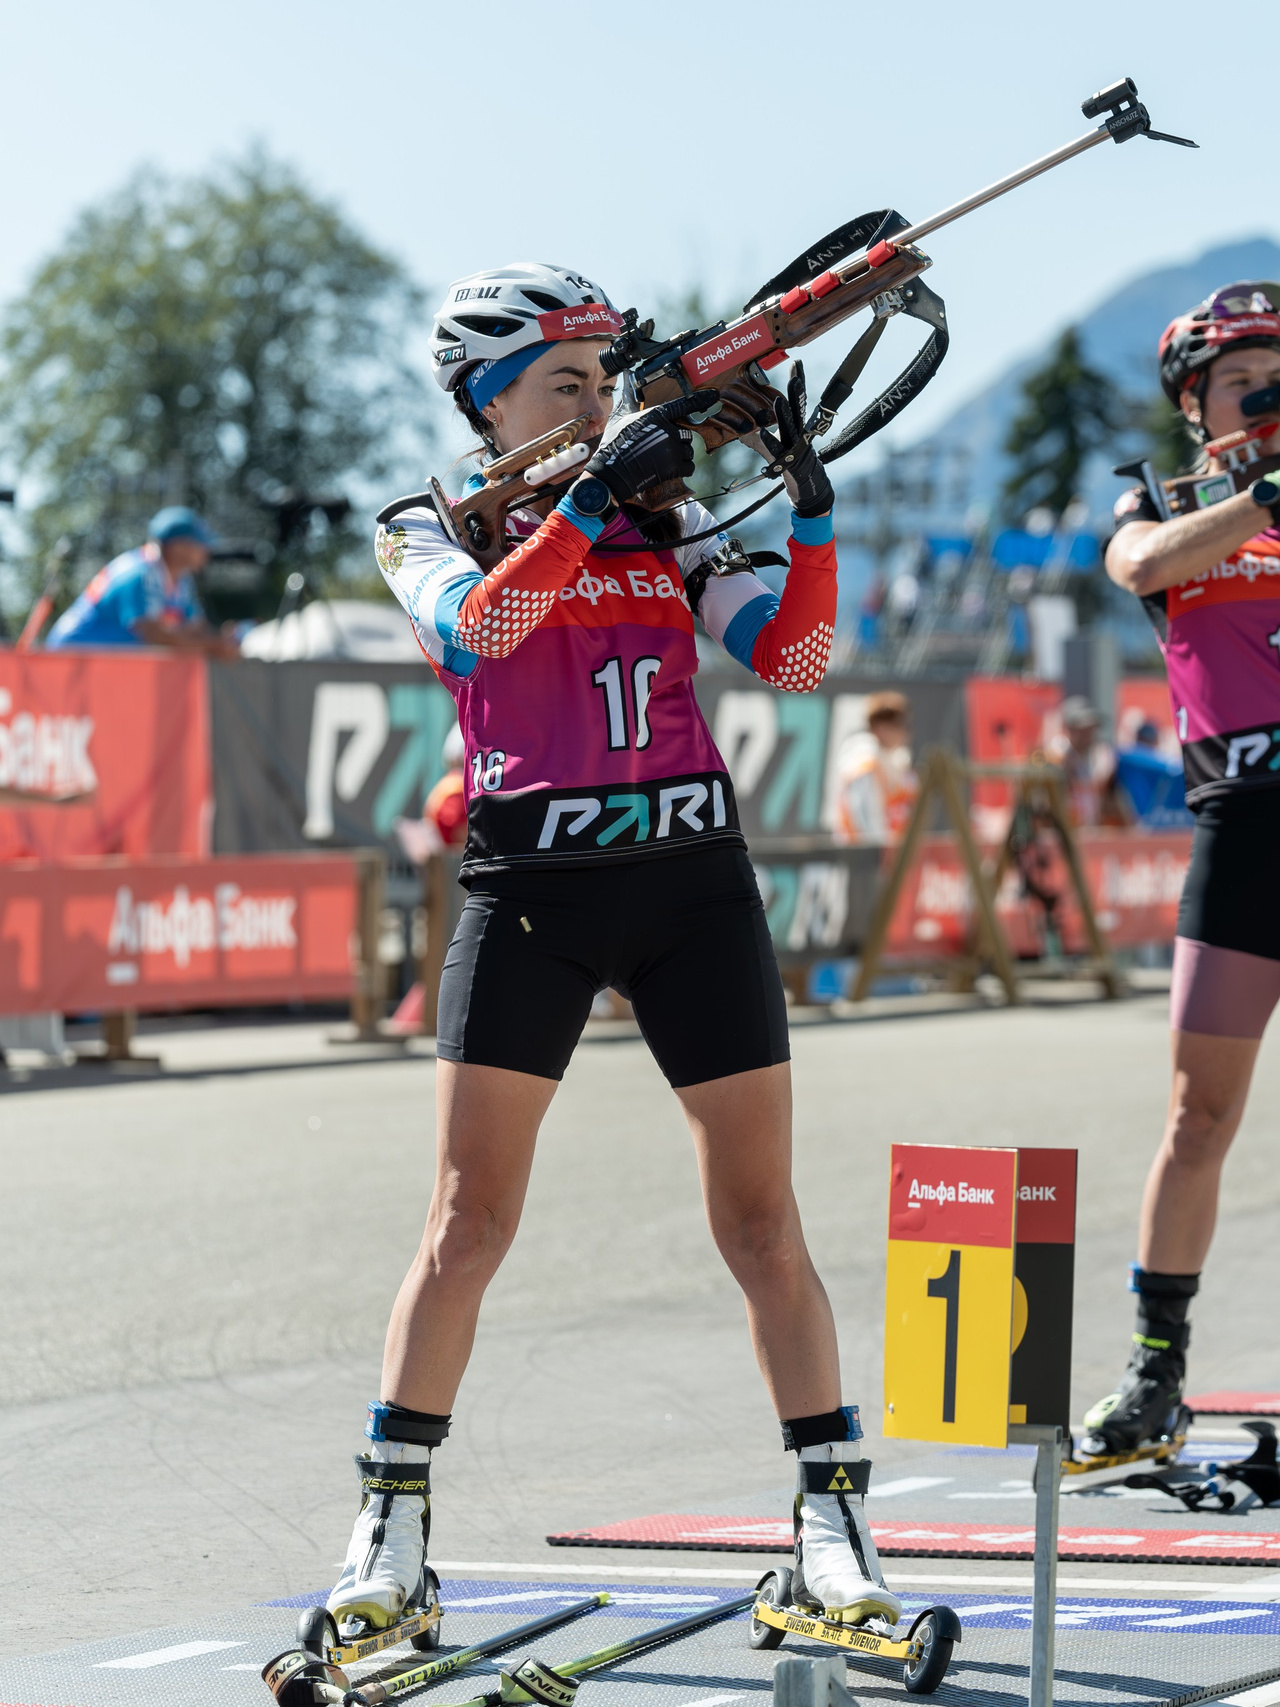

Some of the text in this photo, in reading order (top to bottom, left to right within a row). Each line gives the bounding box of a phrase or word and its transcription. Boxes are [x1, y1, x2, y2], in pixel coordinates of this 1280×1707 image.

[565, 276, 594, 290] 16
[563, 311, 601, 327] Альфа
[695, 327, 762, 371] Альфа Банк
[413, 556, 456, 604] GAZPROM
[471, 750, 506, 793] 16
[537, 779, 727, 850] PARI
[108, 882, 300, 968] Альфа Банк
[908, 1178, 995, 1206] Альфа Банк
[927, 1249, 962, 1424] 1
[357, 1639, 379, 1659] SWENOR
[400, 1619, 421, 1639] SWENOR
[784, 1616, 882, 1652] SWENOR SKATE SWENOR
